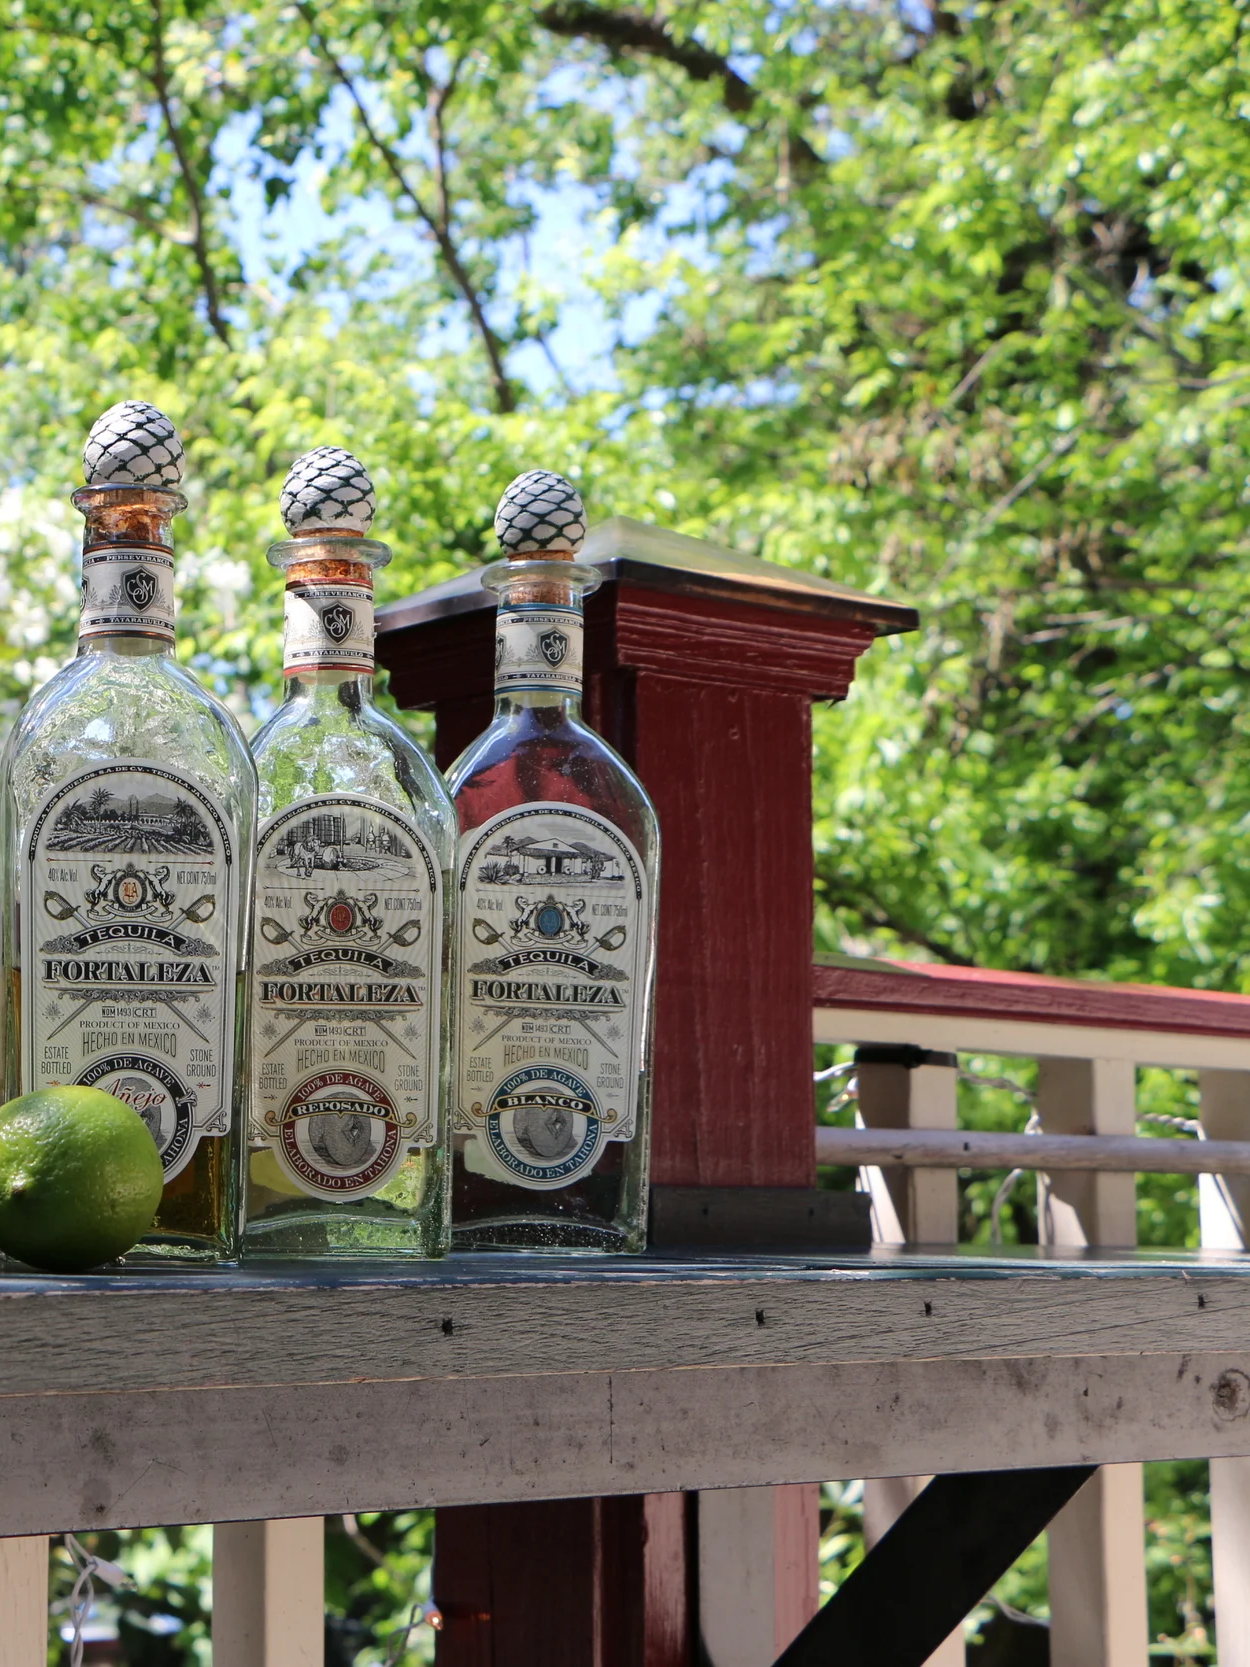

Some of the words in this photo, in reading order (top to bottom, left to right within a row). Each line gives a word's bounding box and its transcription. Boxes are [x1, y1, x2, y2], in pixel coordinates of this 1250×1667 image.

[107, 555, 170, 565] PERSEVERANCIA
[31, 814, 46, 851] TEQUILA
[47, 796, 60, 812] LOS
[80, 926, 176, 948] TEQUILA
[294, 951, 383, 970] TEQUILA
[504, 952, 590, 973] TEQUILA
[42, 960, 216, 984] FORTALEZA
[260, 981, 423, 1005] FORTALEZA
[470, 979, 626, 1006] FORTALEZA
[102, 1007, 115, 1018] NOM
[117, 1008, 132, 1017] 1493
[134, 1008, 156, 1018] CRT
[79, 1020, 125, 1029] PRODUCT
[128, 1021, 140, 1029] OF
[143, 1022, 180, 1030] MEXICO
[315, 1025, 327, 1036] NOM
[328, 1027, 342, 1035] 1493
[344, 1027, 366, 1036] CRT
[83, 1032, 118, 1057] HECHO
[122, 1032, 135, 1045] EN
[294, 1039, 337, 1047] PRODUCT
[502, 1035, 542, 1043] PRODUCT
[545, 1036, 556, 1044] OF
[44, 1047, 69, 1060] ESTATE
[190, 1049, 213, 1062] STONE
[504, 1046, 535, 1067] HECHO
[538, 1047, 550, 1058] EN
[41, 1061, 72, 1075] BOTTLED
[298, 1050, 330, 1073] HECHO
[334, 1050, 345, 1061] EN
[470, 1056, 492, 1069] ESTATE
[82, 1062, 111, 1085] 100%
[114, 1059, 132, 1069] DE
[137, 1060, 174, 1088] AGAVE
[187, 1064, 216, 1077] GROUND
[262, 1063, 285, 1075] ESTATE
[398, 1065, 420, 1077] STONE
[600, 1063, 621, 1075] STONE
[467, 1070, 494, 1082] BOTTLED
[597, 1076, 624, 1089] GROUND
[259, 1077, 287, 1090] BOTTLED
[298, 1078, 323, 1100] 100%
[326, 1074, 343, 1084] DE
[347, 1076, 383, 1101] AGAVE
[395, 1080, 423, 1091] GROUND
[503, 1073, 528, 1093] 100%
[531, 1070, 548, 1078] DE
[552, 1071, 586, 1097] AGAVE
[100, 1078, 167, 1111] Añejo
[297, 1101, 386, 1116] REPOSADO
[507, 1097, 583, 1110] BLANCO
[490, 1119, 543, 1178] ELABORADO
[546, 1167, 565, 1178] EN
[566, 1124, 598, 1169] TAHONA
[284, 1128, 341, 1188] ELABORADO
[344, 1176, 364, 1187] EN
[365, 1129, 397, 1178] TAHONA
